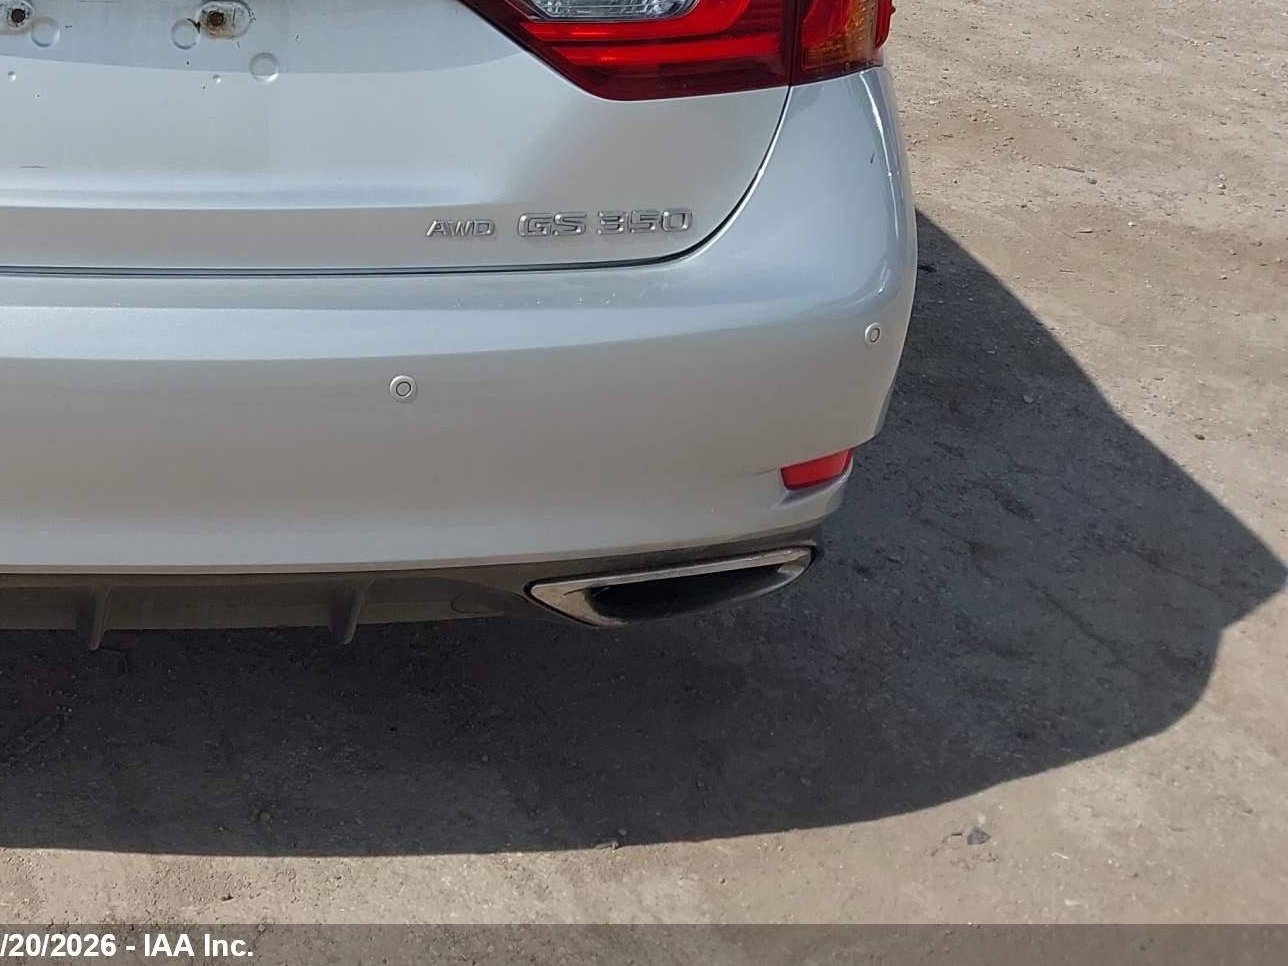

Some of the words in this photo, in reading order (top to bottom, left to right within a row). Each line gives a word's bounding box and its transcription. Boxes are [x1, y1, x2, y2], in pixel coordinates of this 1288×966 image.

[426, 219, 495, 236] AWD
[517, 212, 587, 237] GS
[597, 209, 693, 234] 350
